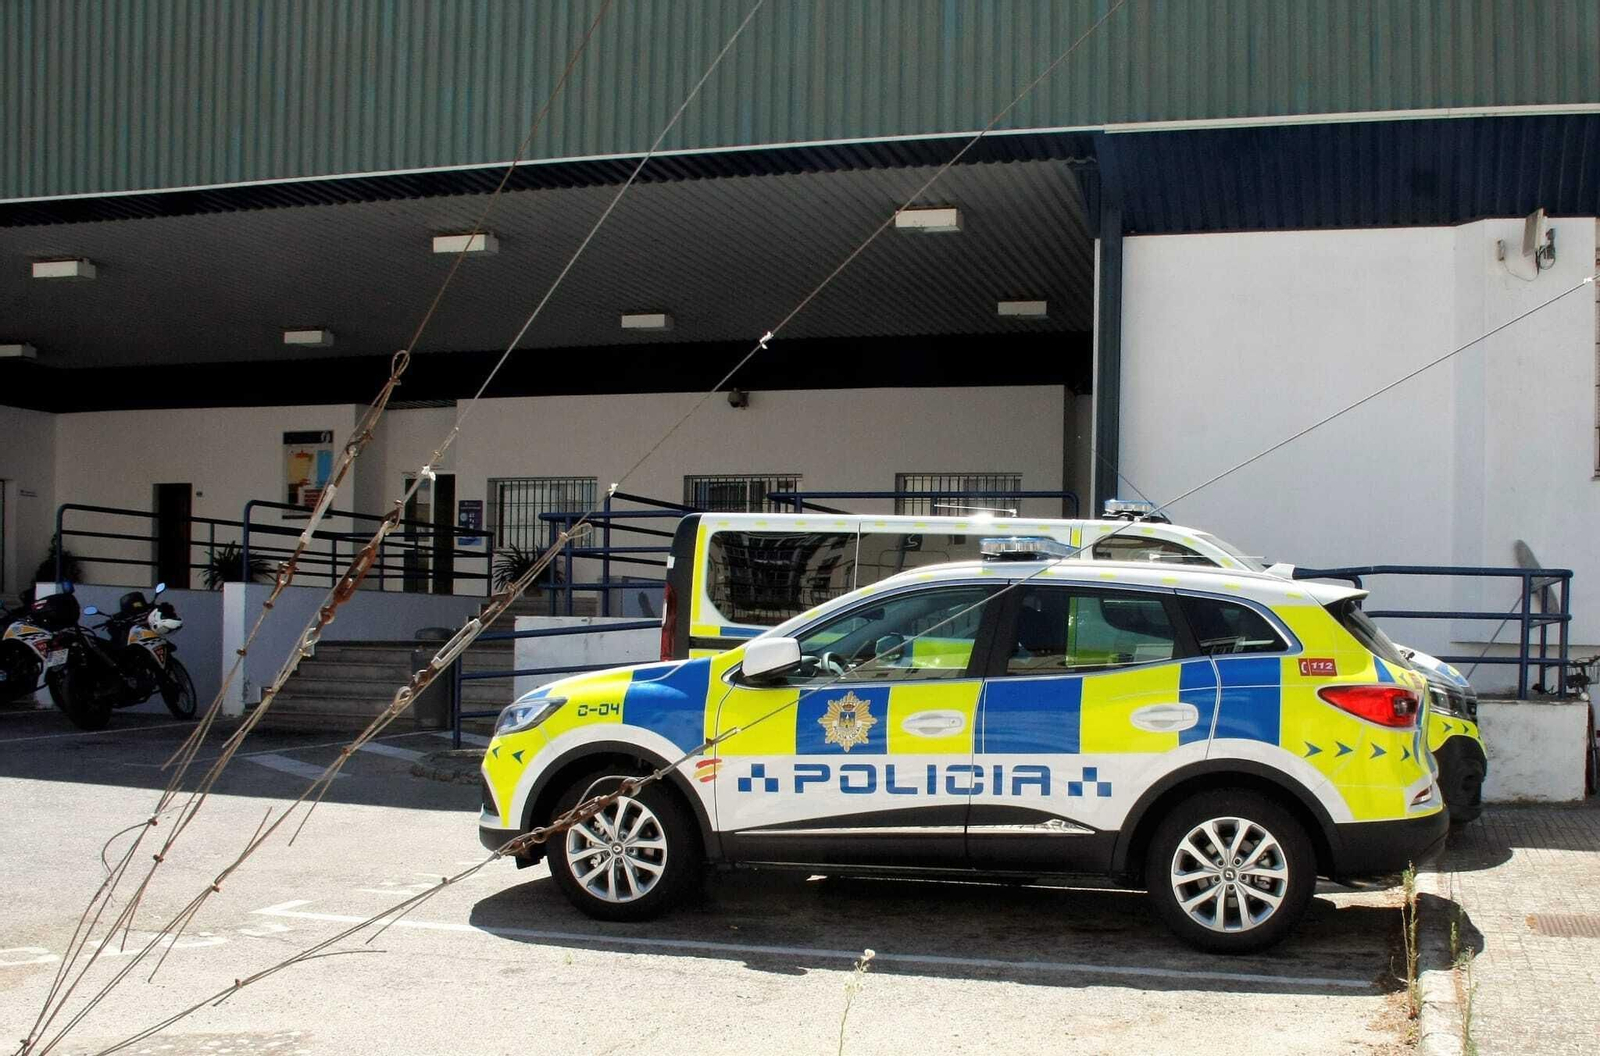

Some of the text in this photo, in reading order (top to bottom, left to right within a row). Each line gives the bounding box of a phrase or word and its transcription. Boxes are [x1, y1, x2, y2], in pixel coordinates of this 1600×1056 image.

[1311, 661, 1333, 670] 112
[578, 703, 620, 717] C-04
[793, 763, 1051, 796] POLICIA
